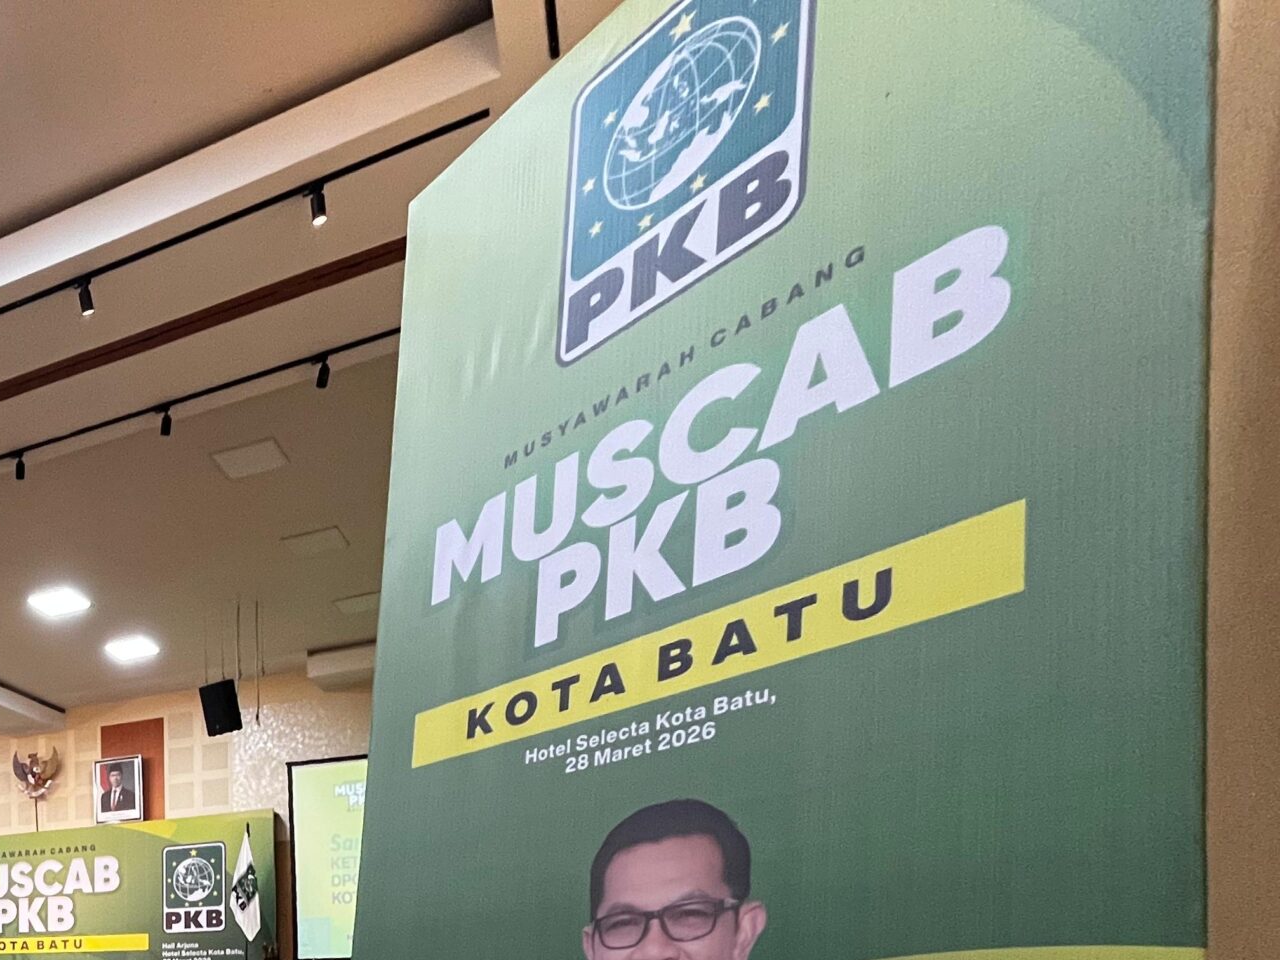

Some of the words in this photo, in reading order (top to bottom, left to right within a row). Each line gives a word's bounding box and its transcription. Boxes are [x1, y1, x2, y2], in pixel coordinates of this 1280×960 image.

[564, 148, 793, 354] PKB
[504, 345, 696, 469] MUSYAWARAH
[710, 245, 865, 348] CABANG
[431, 225, 1011, 607] MUSCAB
[534, 457, 782, 648] PKB
[466, 662, 626, 739] KOTA
[657, 567, 894, 682] BATU
[525, 739, 571, 764] Hotel
[576, 722, 650, 752] Selecta
[656, 705, 706, 731] Kota
[714, 687, 777, 716] Batu,
[565, 756, 589, 774] 28
[594, 742, 652, 767] Maret
[658, 721, 716, 753] 2026
[335, 783, 366, 796] MUS
[50, 844, 96, 855] CABANG
[331, 856, 358, 870] KET
[37, 939, 83, 950] BATU
[165, 909, 224, 930] PKB
